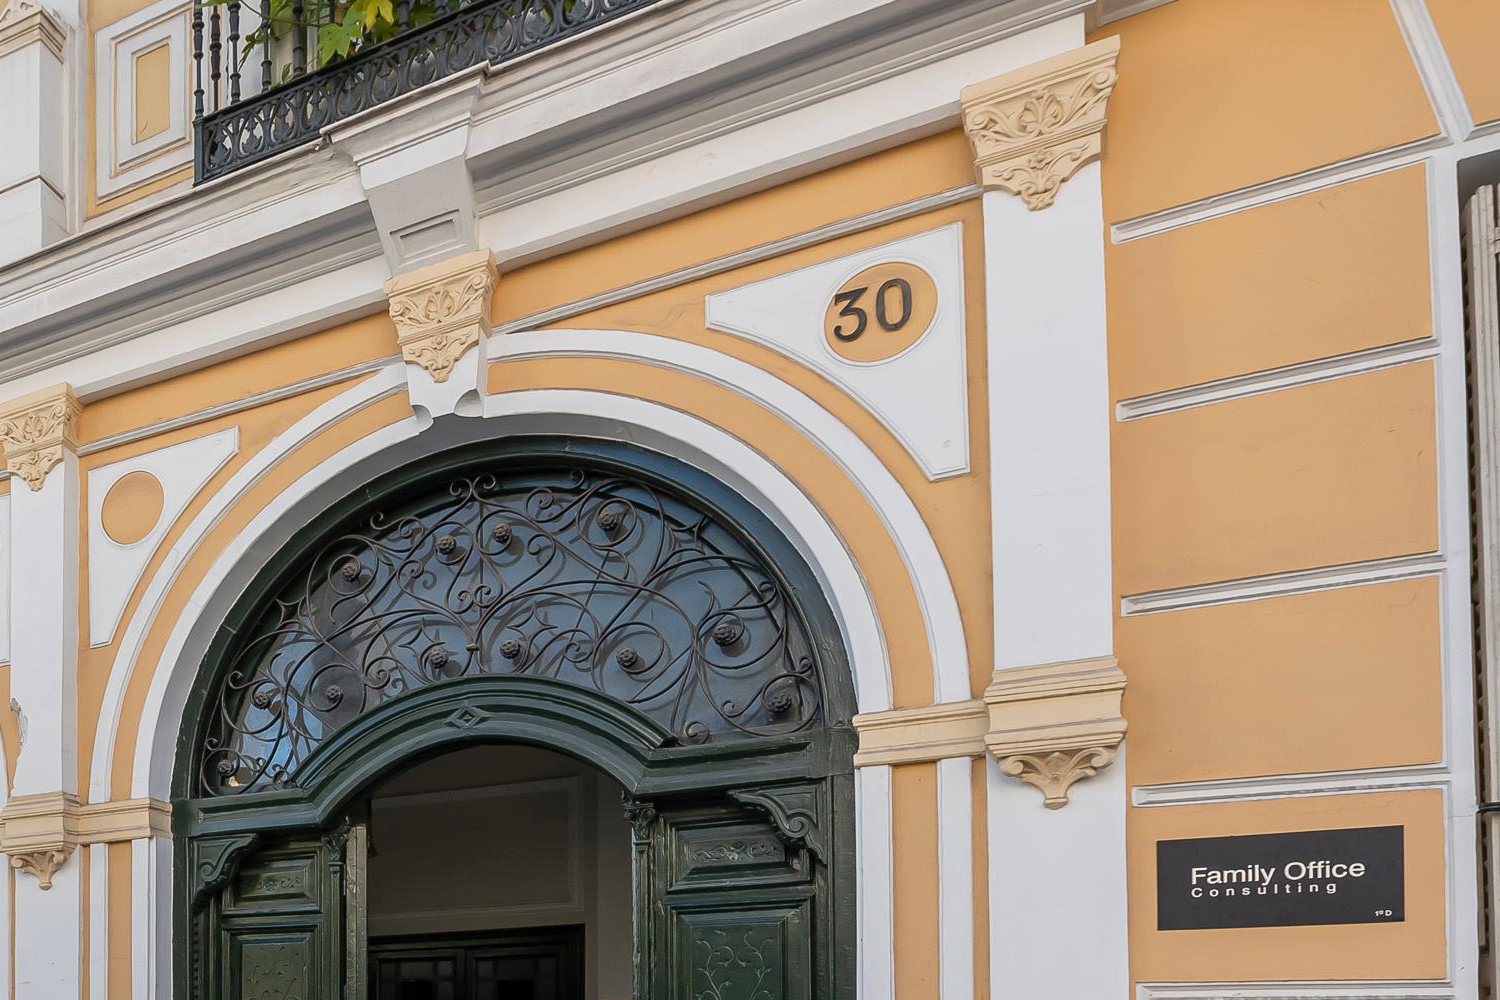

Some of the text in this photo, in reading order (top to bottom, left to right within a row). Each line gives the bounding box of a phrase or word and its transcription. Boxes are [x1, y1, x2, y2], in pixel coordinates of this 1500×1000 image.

[833, 278, 913, 342] 30
[1190, 860, 1366, 887] Family Office
[1190, 882, 1338, 898] Consulting
